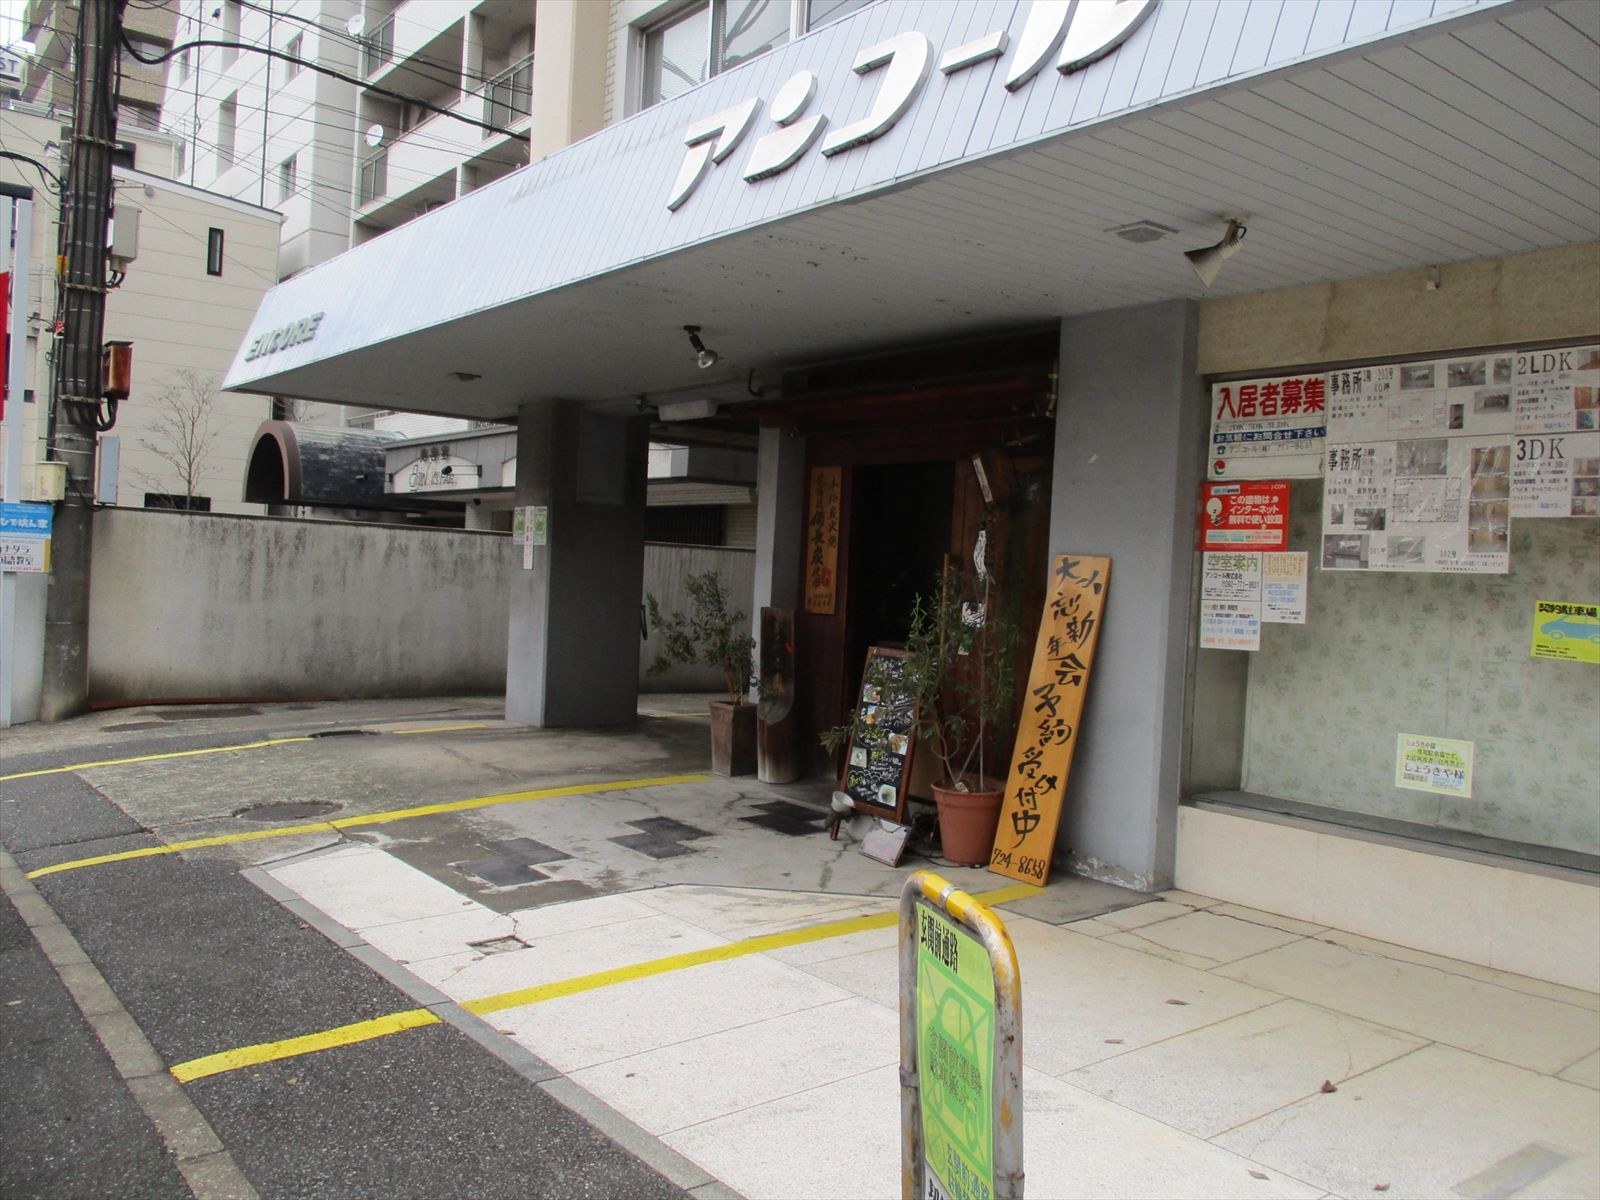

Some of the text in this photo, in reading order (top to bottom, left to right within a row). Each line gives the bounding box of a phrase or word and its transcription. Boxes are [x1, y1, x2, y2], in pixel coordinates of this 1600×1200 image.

[244, 312, 326, 363] ENCORE
[1518, 351, 1573, 376] 2LDK
[1330, 370, 1361, 396] 事務所
[1217, 378, 1325, 420] 入居者募集
[1327, 447, 1362, 471] 事務所
[1516, 438, 1565, 461] 3DK
[1230, 504, 1280, 515] インターネット
[1208, 554, 1258, 572] 空室案内
[1538, 603, 1597, 618] 契約駐車場
[920, 909, 958, 974] 玄関前通路
